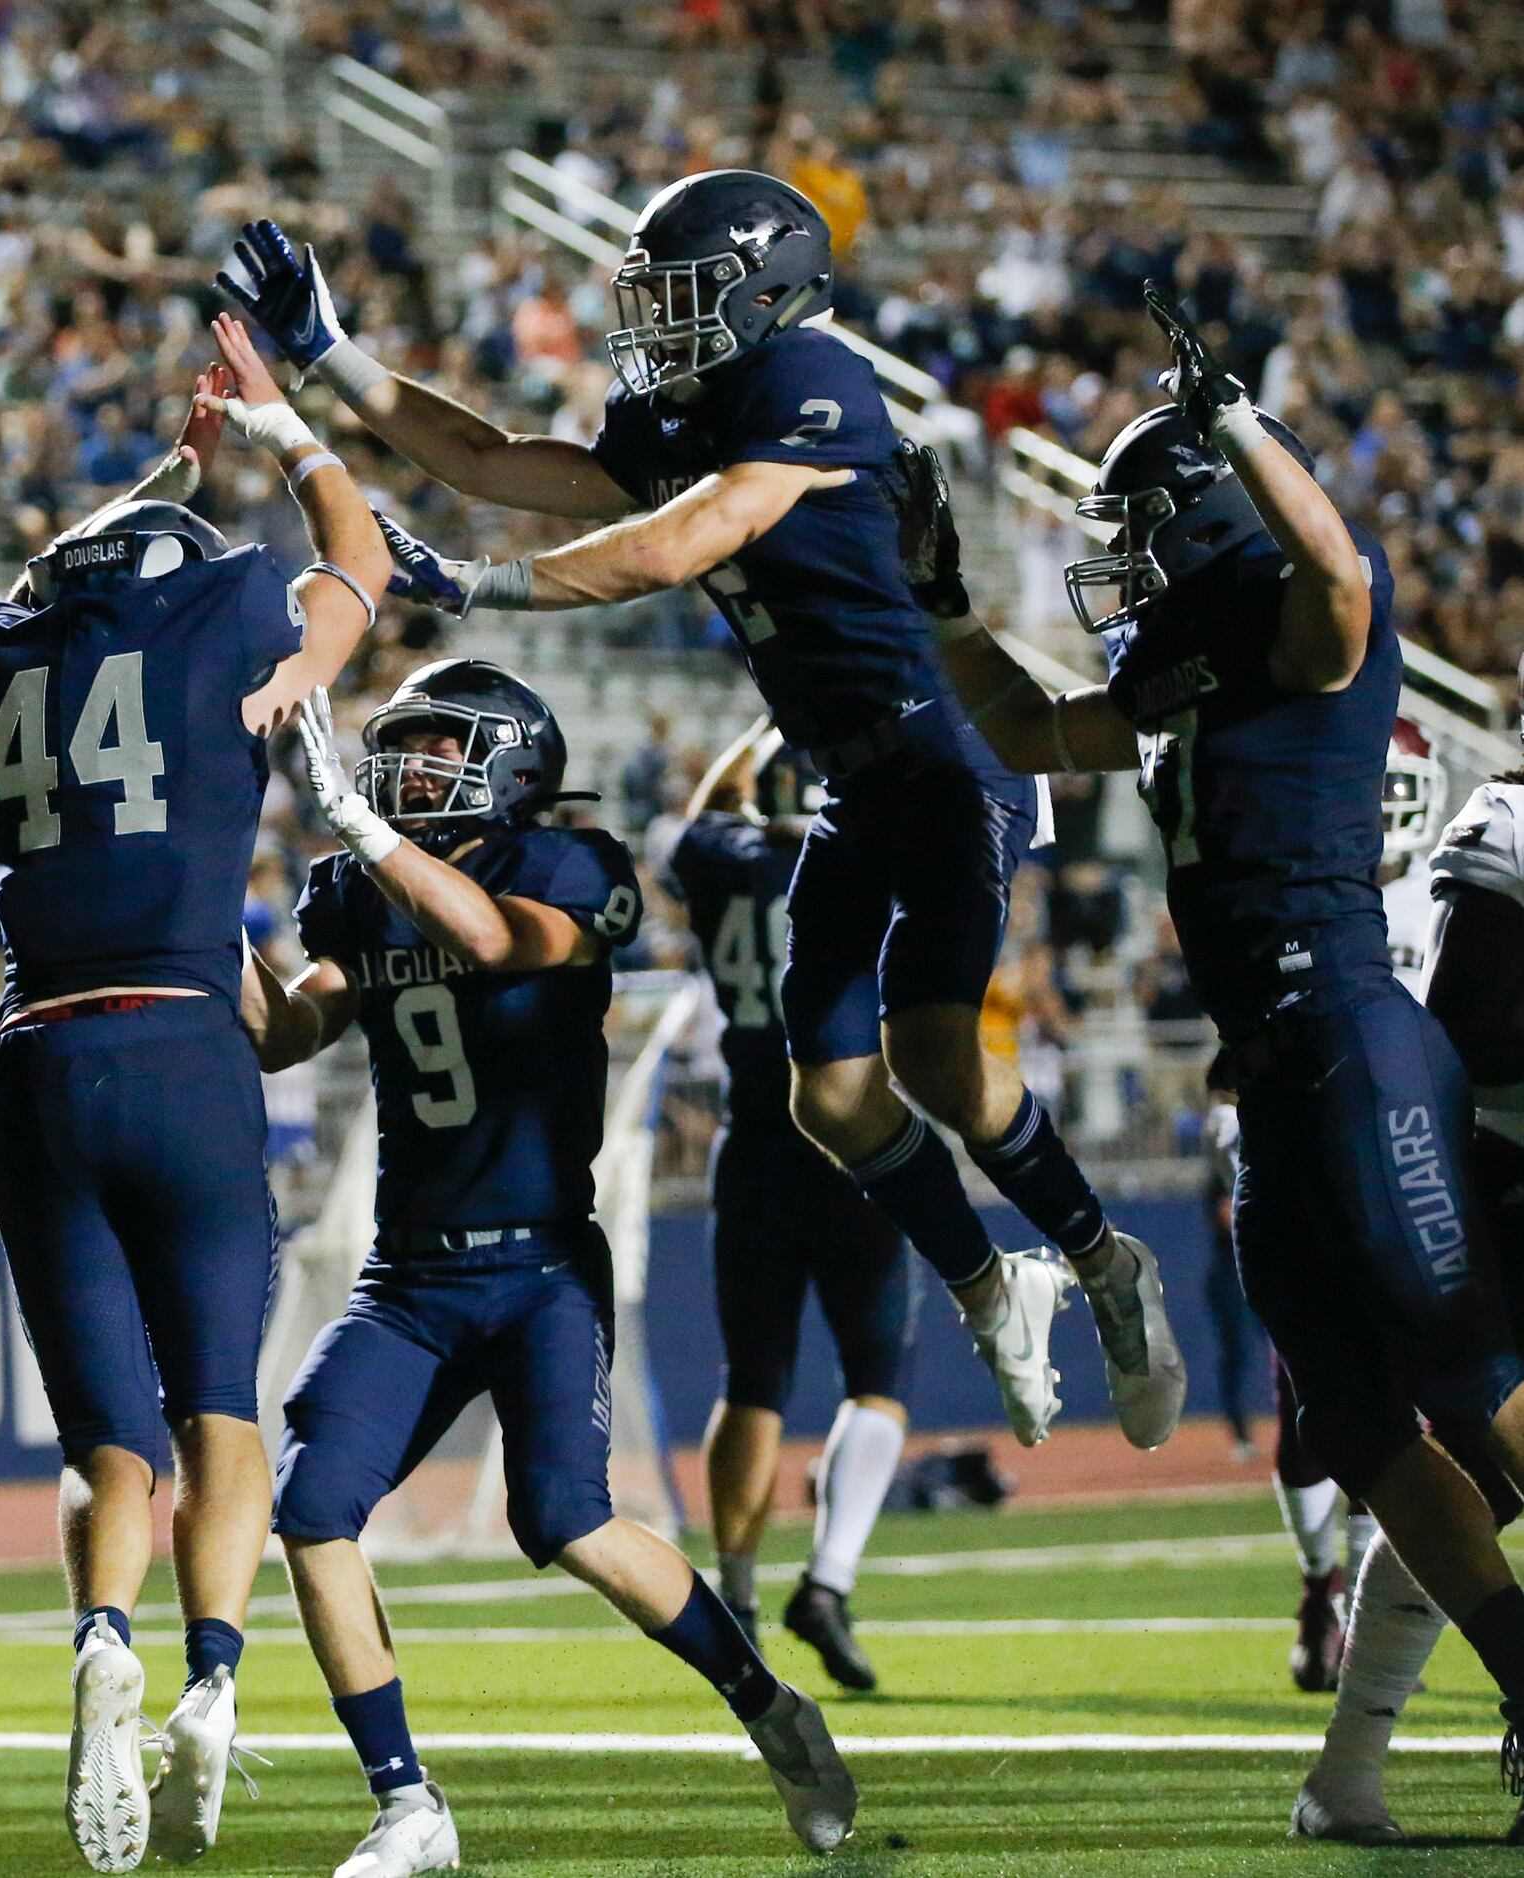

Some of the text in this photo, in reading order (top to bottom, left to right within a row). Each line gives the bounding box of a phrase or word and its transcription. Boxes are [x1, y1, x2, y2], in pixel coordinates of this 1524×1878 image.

[780, 398, 843, 449] 2
[64, 540, 126, 570] DOUGLAS
[594, 884, 636, 938] 9
[360, 948, 475, 990] JGUA
[1285, 940, 1299, 953] M
[394, 983, 477, 1129] 9
